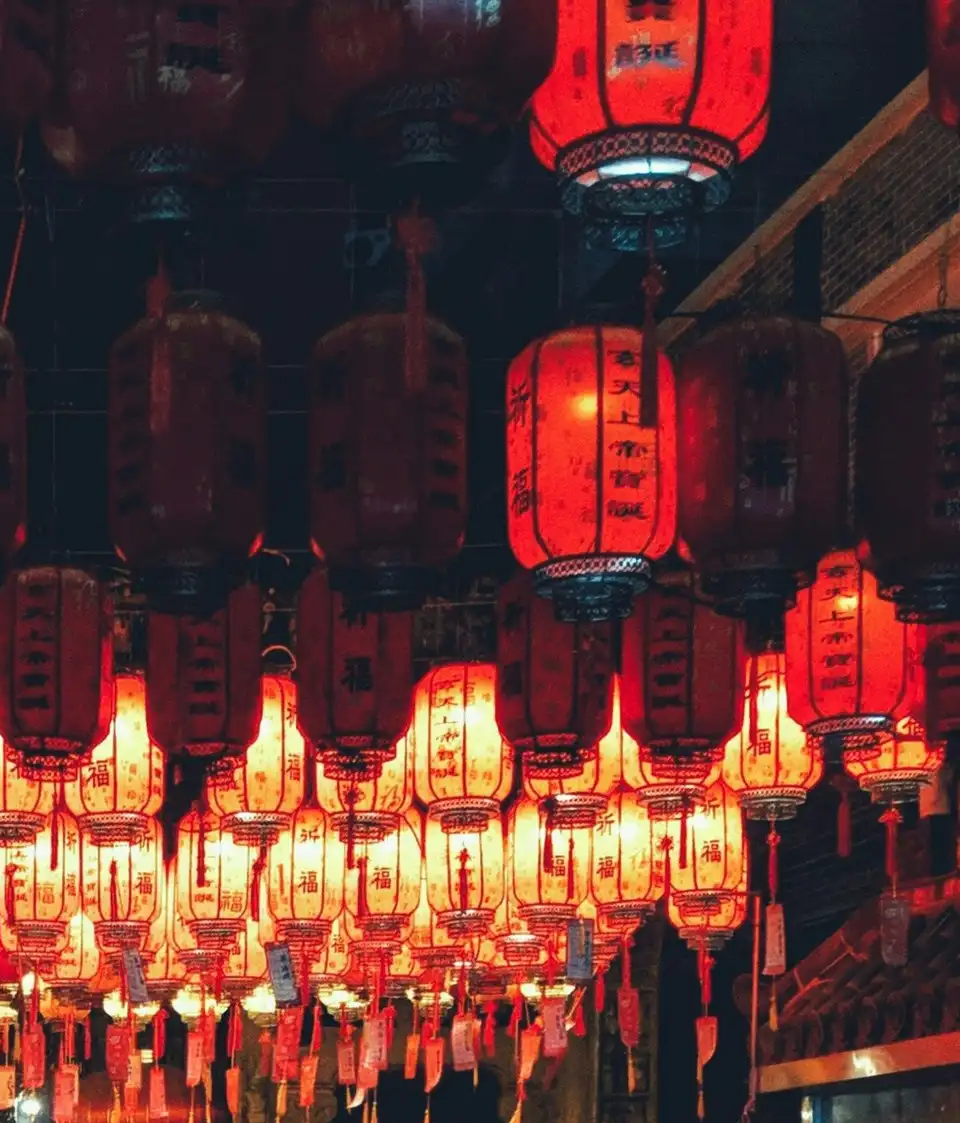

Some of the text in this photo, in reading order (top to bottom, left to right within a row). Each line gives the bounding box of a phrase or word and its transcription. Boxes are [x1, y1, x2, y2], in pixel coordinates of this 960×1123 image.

[86, 758, 110, 789] 福
[297, 828, 321, 894] 祈福
[596, 812, 617, 880] 祈福
[701, 797, 723, 864] 祈福
[370, 867, 393, 891] 福
